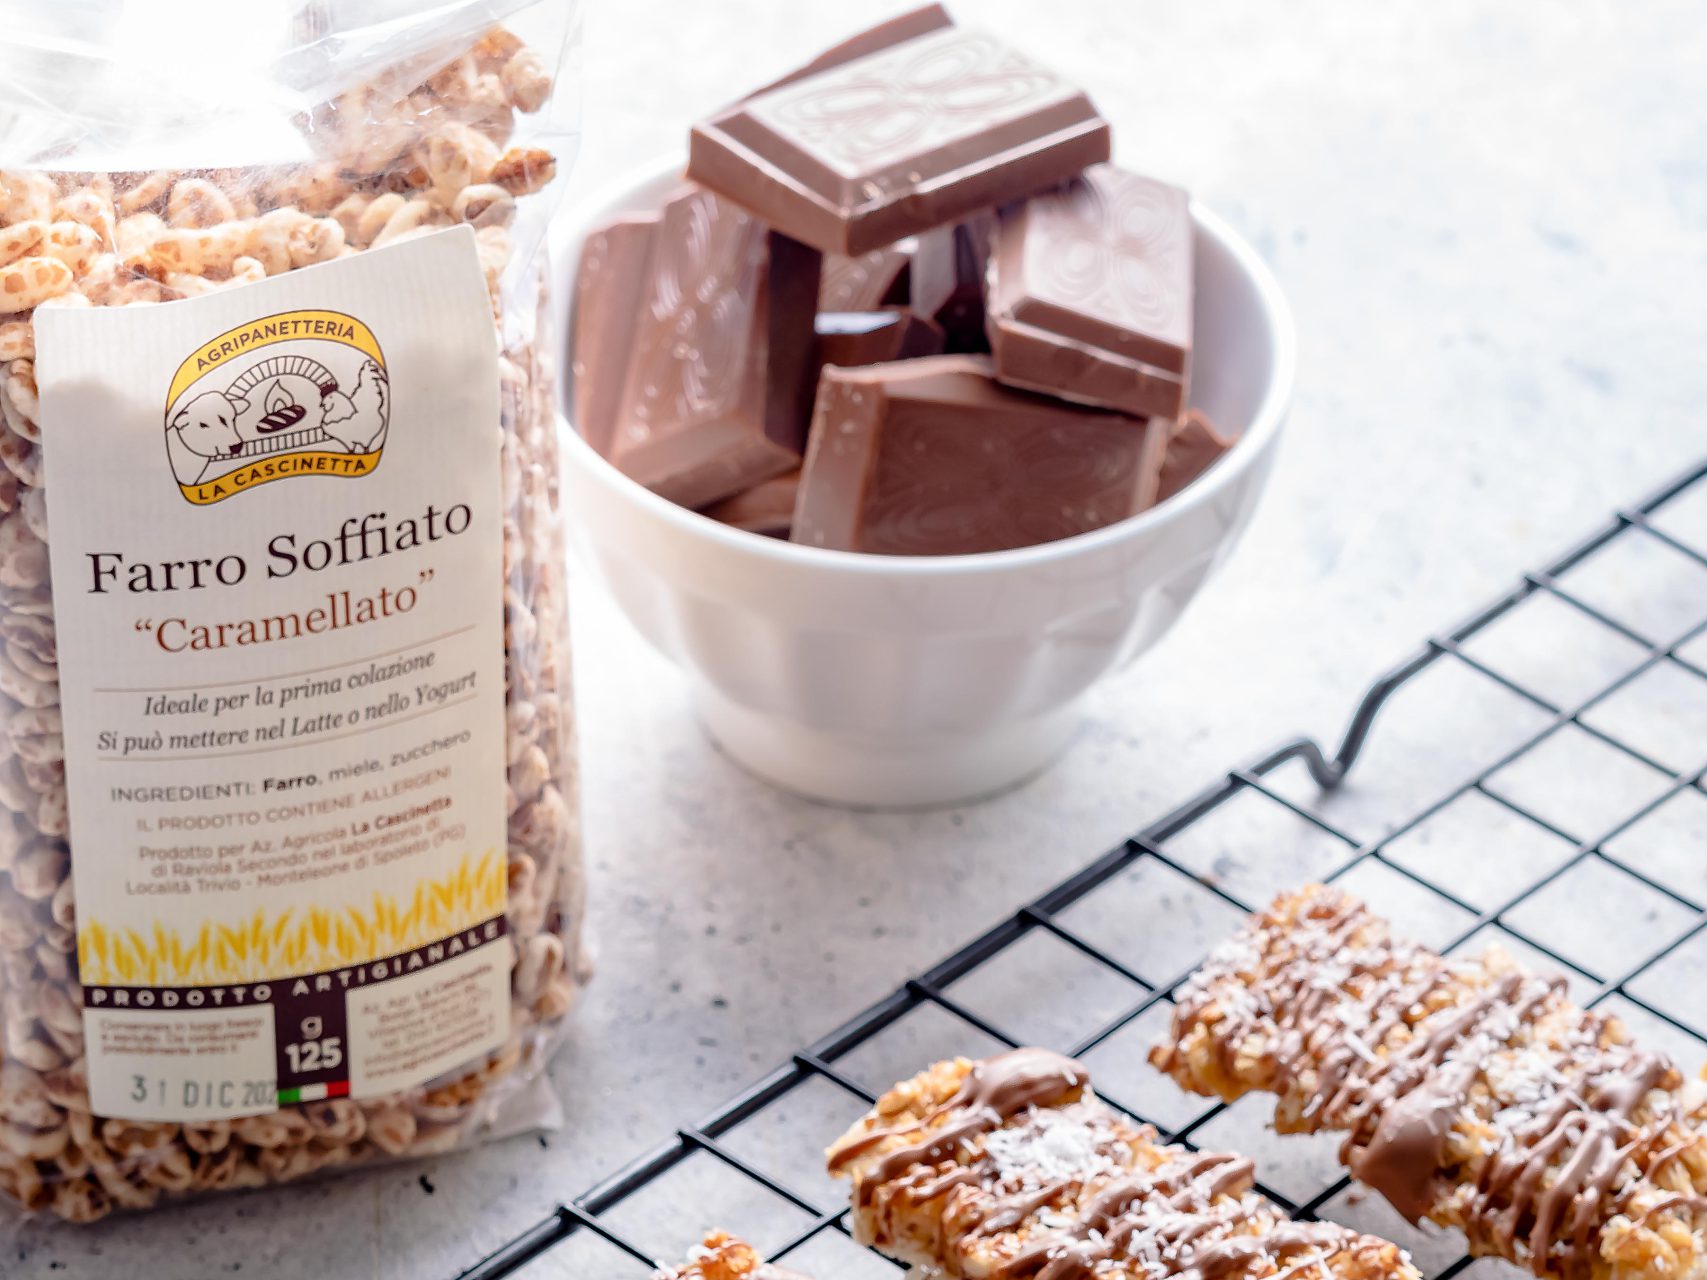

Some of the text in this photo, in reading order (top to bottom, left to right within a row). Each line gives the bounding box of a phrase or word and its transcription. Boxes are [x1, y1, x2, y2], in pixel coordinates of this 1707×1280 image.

[195, 319, 355, 372] AGRIPANETTERIA
[197, 456, 367, 501] LA CASCINETTA
[86, 502, 473, 594] Farro Soffiato
[134, 568, 436, 653] “Caramellato”
[97, 670, 477, 756] Si può mettere nel Latte o nello Yogurt
[143, 651, 436, 717] Ideale per la prima colazione
[110, 729, 472, 803] INGREDIENTI: Farro, miele, zucchero
[136, 764, 453, 833] IL PRODOTTO CONTIENE ALLERGENI
[138, 844, 214, 862] Prodotto
[217, 843, 245, 860] per
[282, 826, 347, 851] Agricola
[351, 821, 371, 837] La
[374, 796, 453, 831] Cascinetta
[125, 878, 192, 897] Località
[197, 876, 242, 894] Trivio
[151, 863, 168, 879] di
[91, 919, 500, 1008] PRODOTTO ARTIGIANALE
[284, 1036, 344, 1075] 125
[300, 1014, 324, 1041] g
[182, 1077, 235, 1109] DIC
